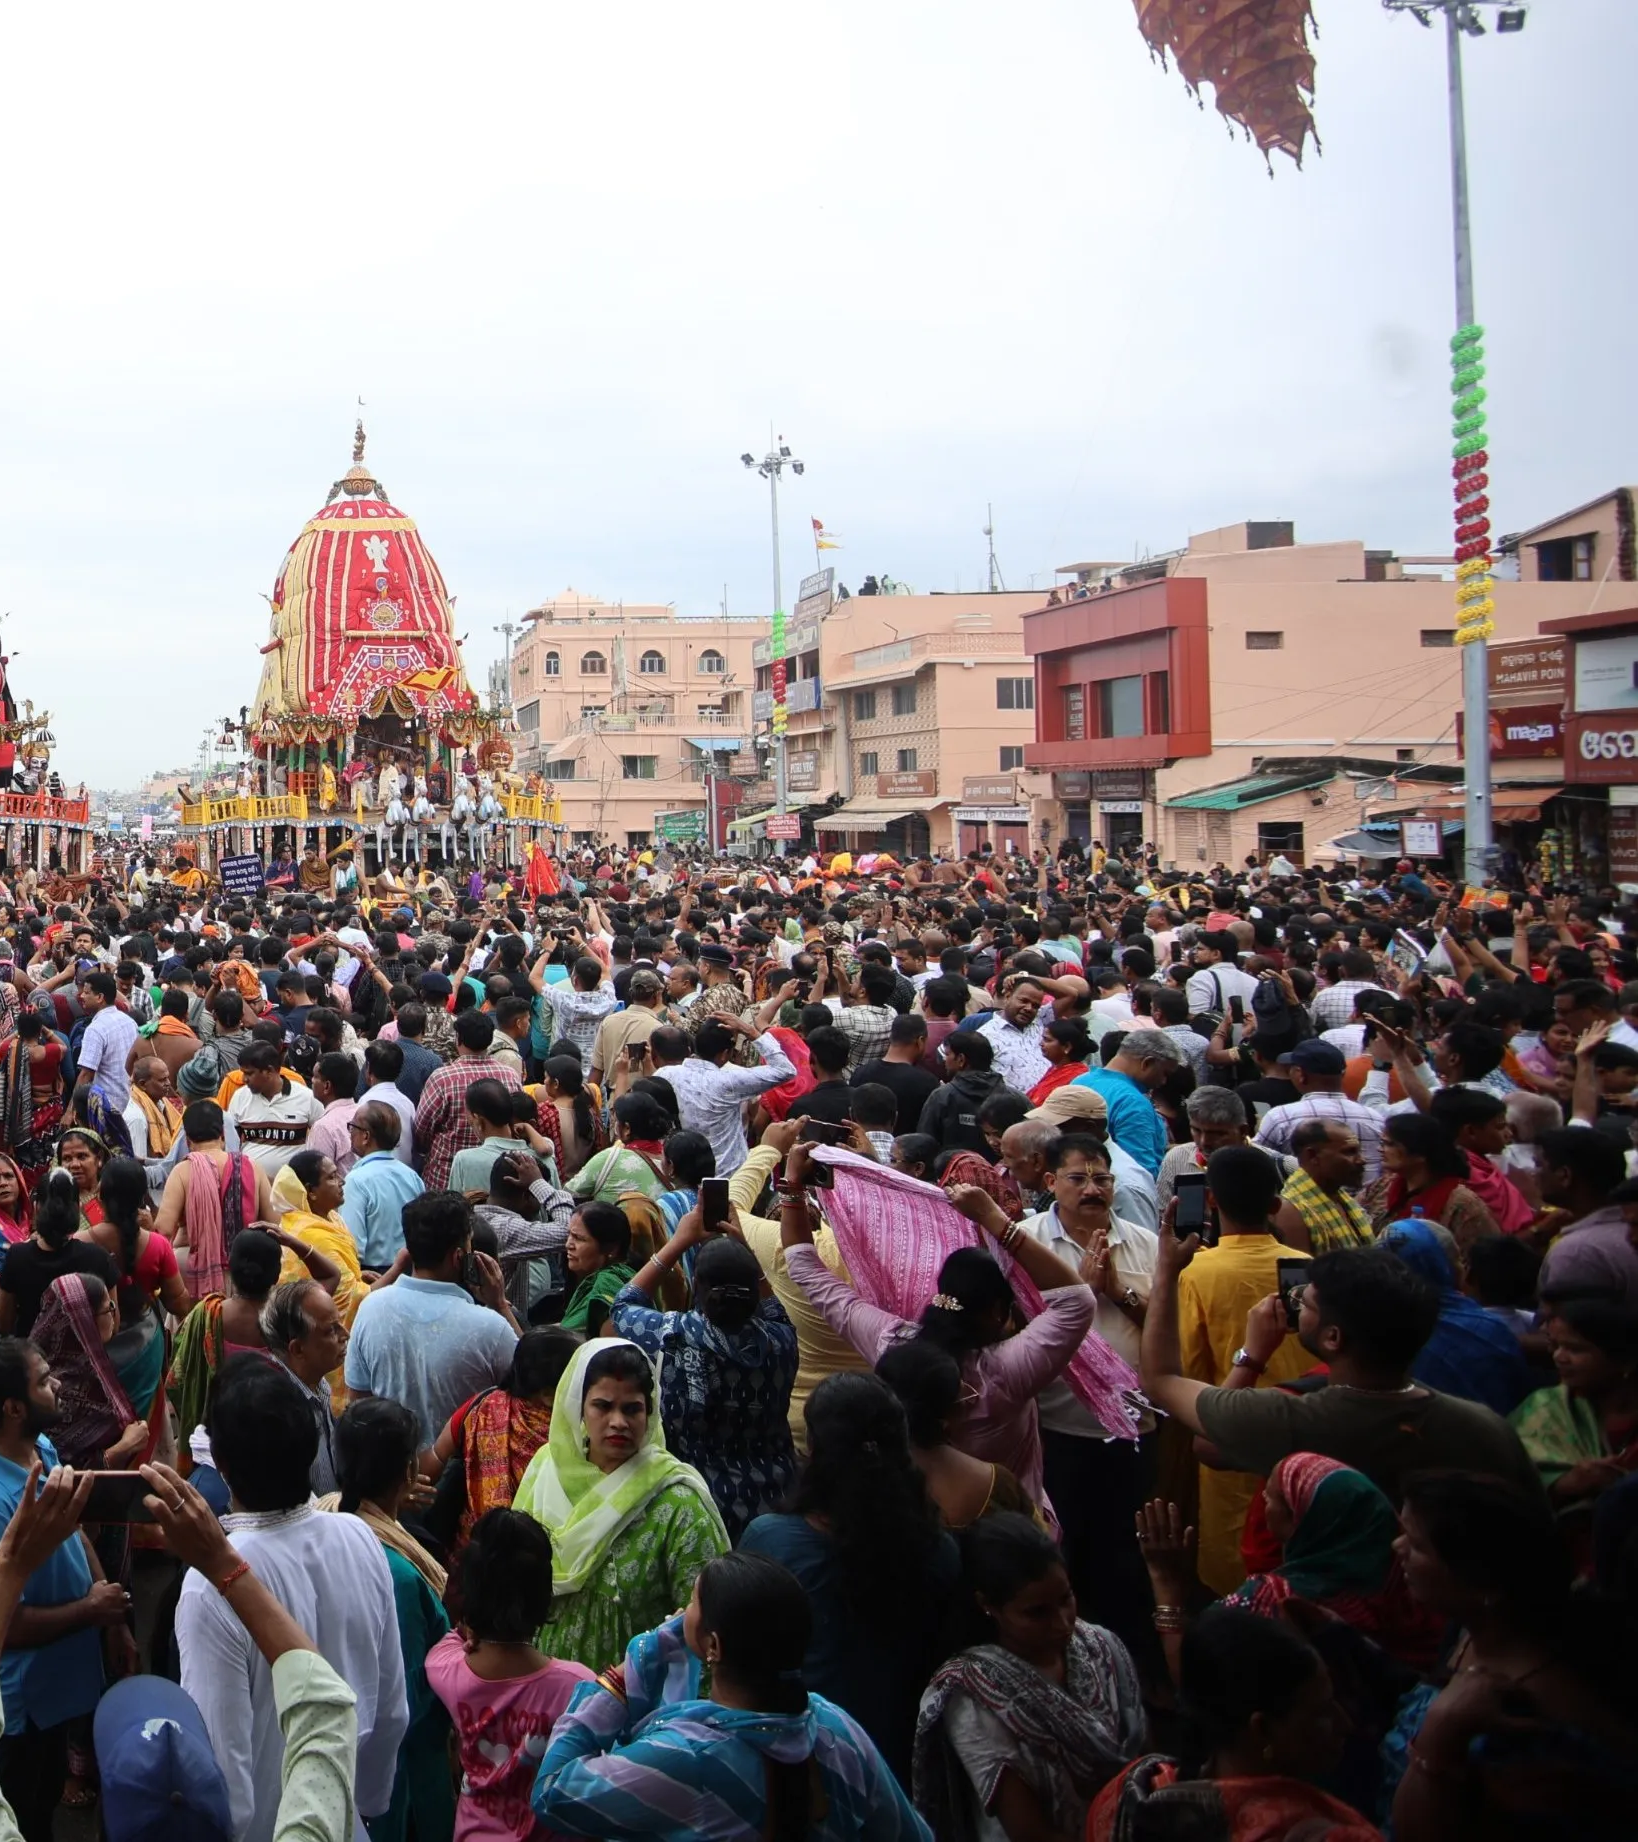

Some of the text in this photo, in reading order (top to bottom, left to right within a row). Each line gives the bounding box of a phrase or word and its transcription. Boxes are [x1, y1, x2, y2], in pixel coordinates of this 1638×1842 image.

[1495, 667, 1566, 685] MAHAVIR POIN
[1507, 723, 1554, 741] maaza
